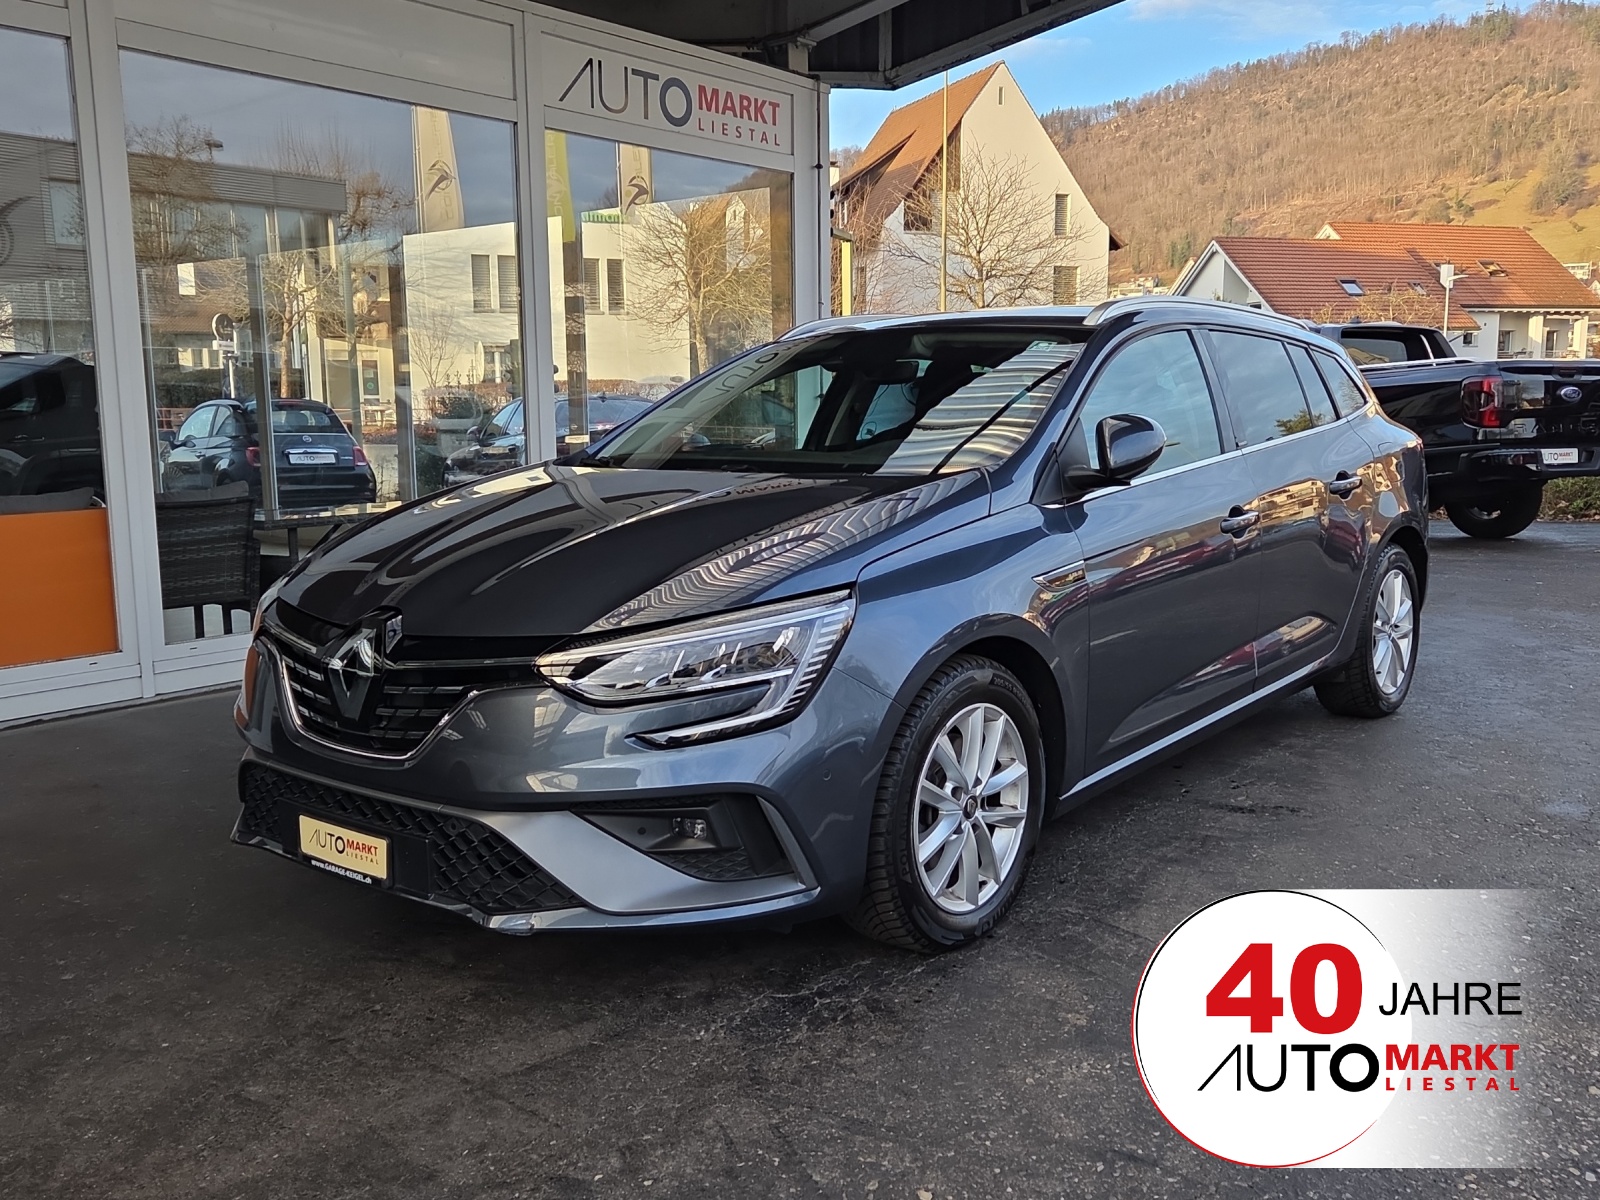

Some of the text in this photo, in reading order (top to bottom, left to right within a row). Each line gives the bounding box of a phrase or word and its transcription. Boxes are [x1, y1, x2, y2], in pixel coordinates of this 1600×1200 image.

[558, 58, 780, 127] AUTO MARKT
[698, 117, 780, 147] LIESTAL
[309, 829, 378, 857] AUTO MARKT
[346, 851, 379, 865] LIESTAL
